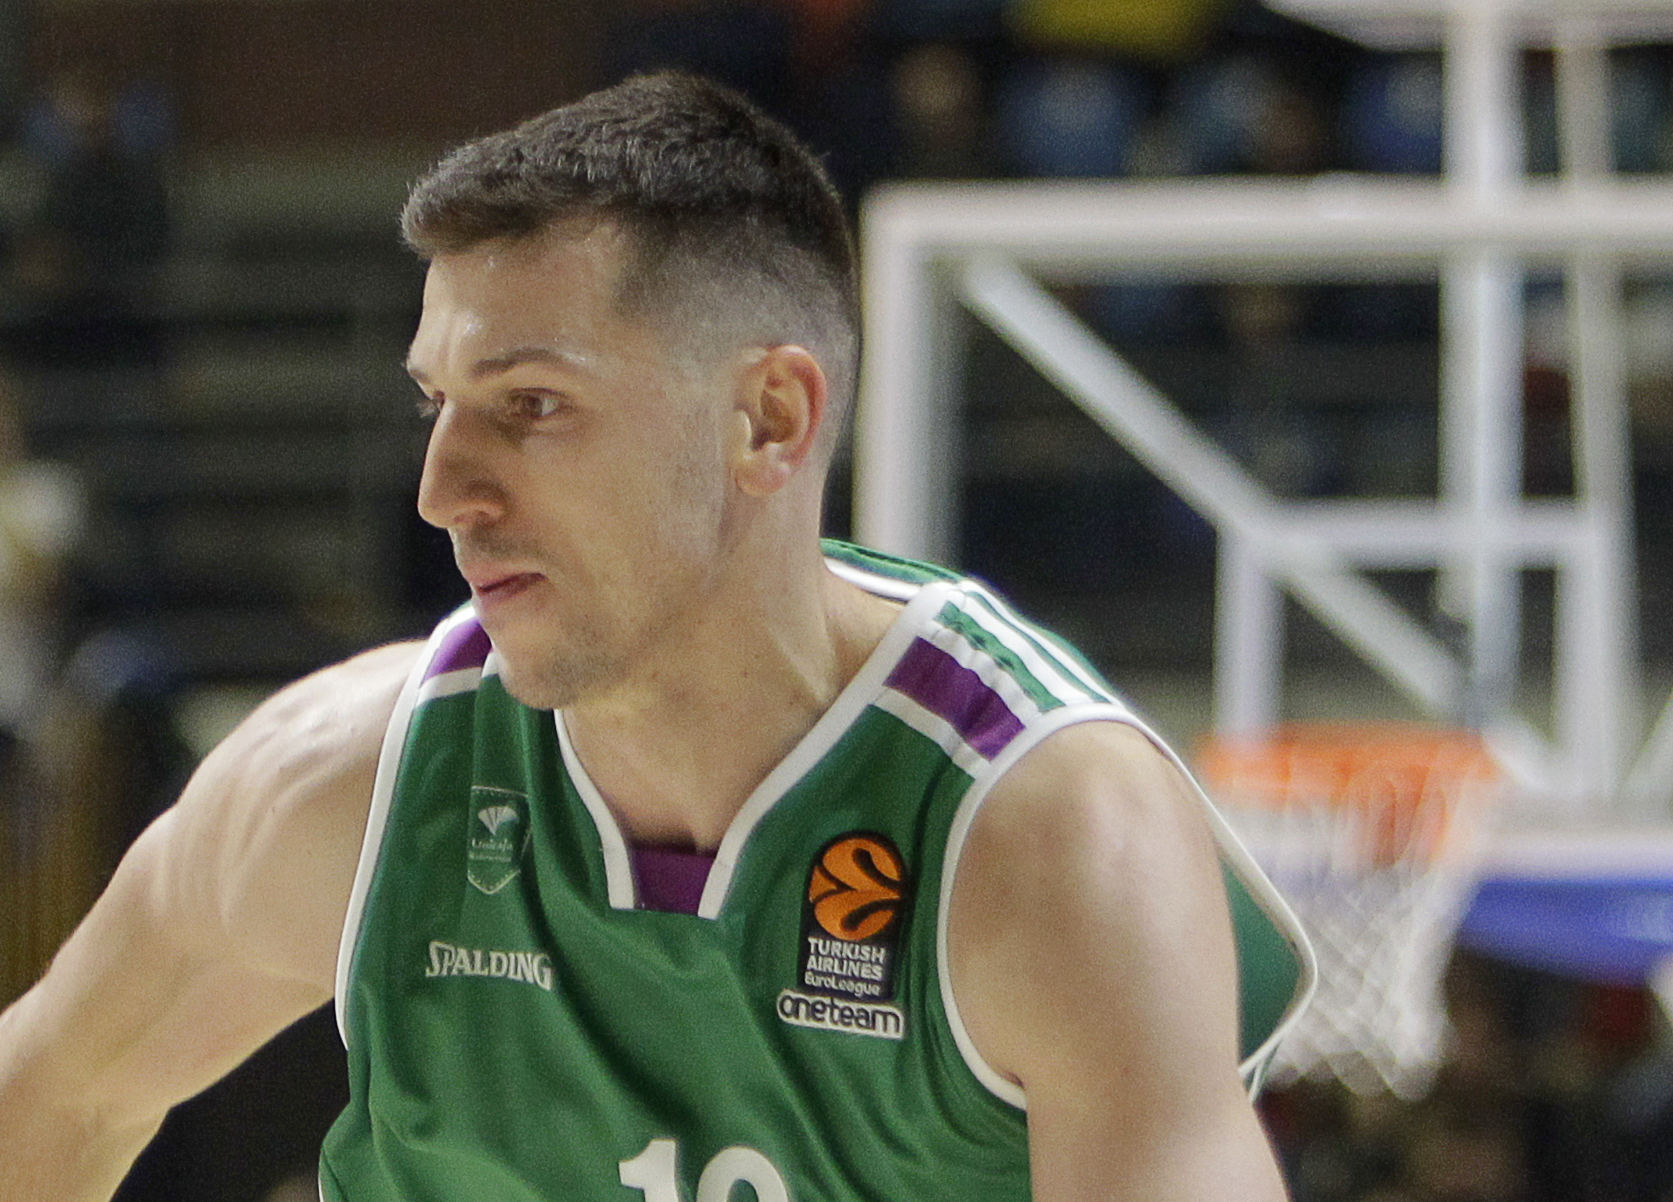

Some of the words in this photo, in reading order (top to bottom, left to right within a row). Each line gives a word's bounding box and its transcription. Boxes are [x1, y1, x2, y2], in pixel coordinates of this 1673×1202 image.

[808, 937, 886, 964] TURKISH
[426, 941, 553, 990] SPALDING
[806, 955, 883, 982] AIRLINES
[805, 971, 880, 997] EuroLeague
[779, 995, 901, 1035] oneteam
